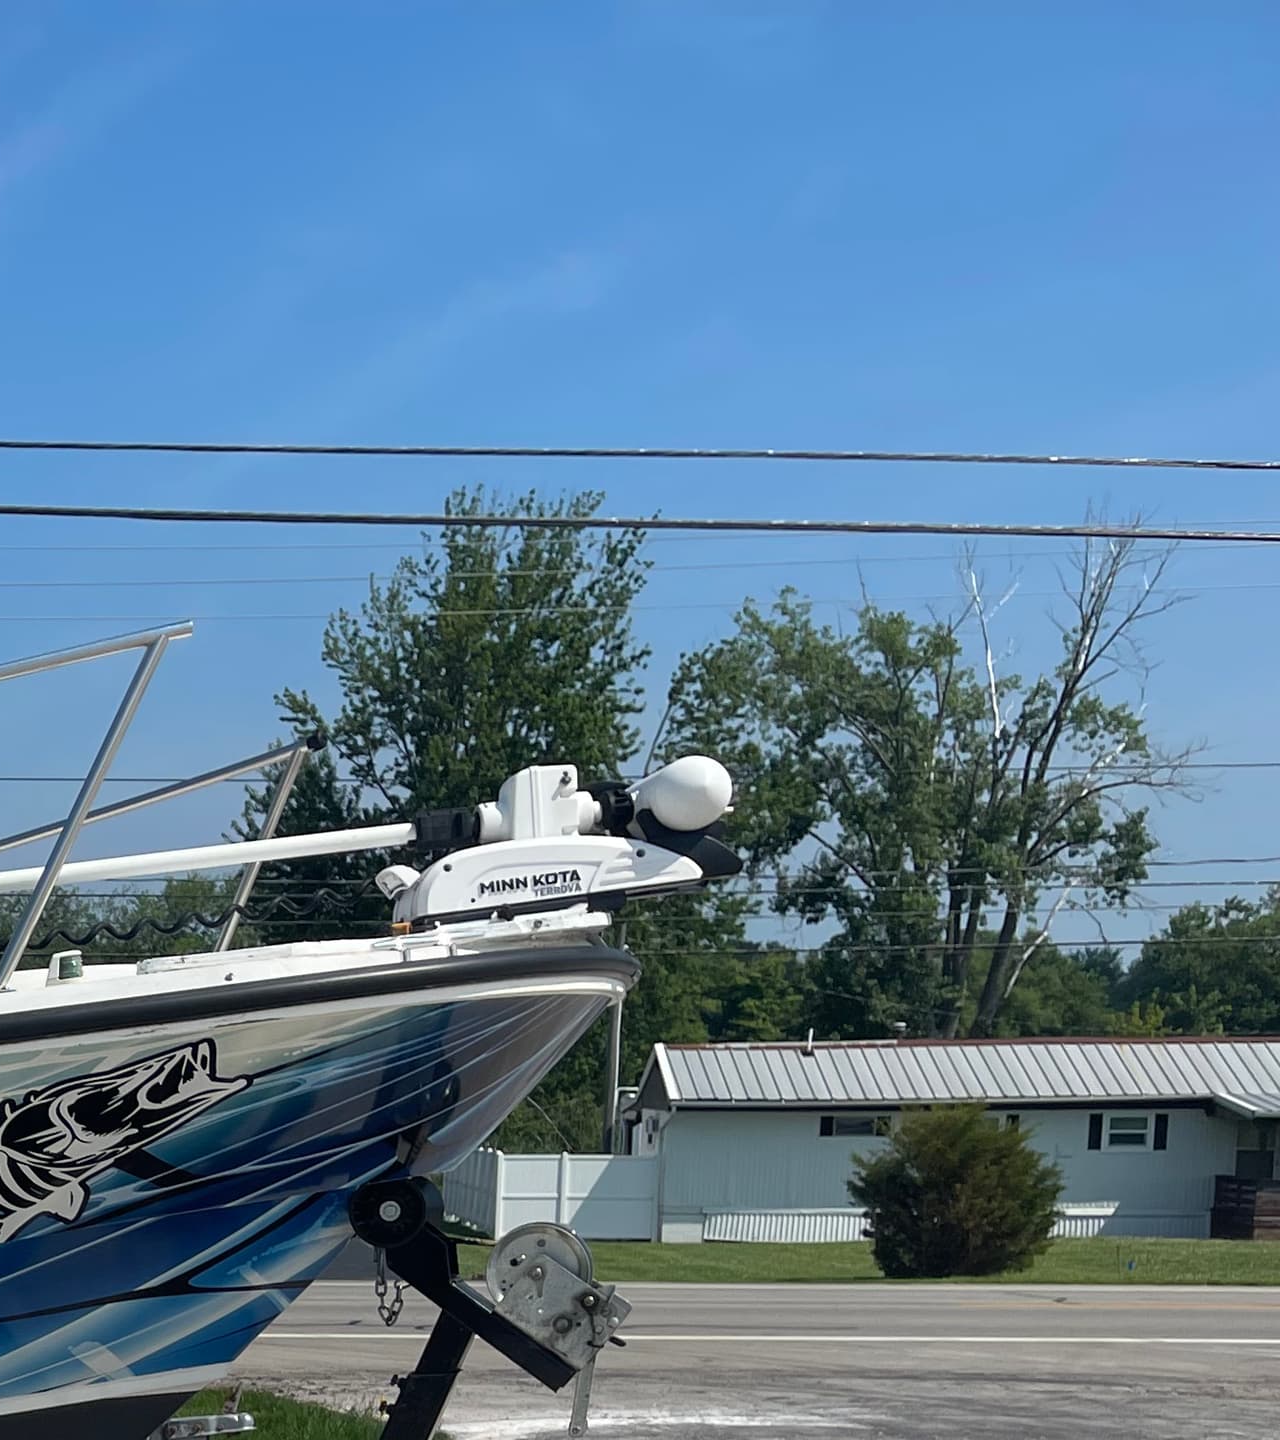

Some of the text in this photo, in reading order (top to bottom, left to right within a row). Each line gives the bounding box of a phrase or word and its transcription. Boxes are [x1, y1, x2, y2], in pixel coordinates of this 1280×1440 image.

[479, 869, 582, 894] MINN KOTA
[533, 883, 582, 897] TERROVA
